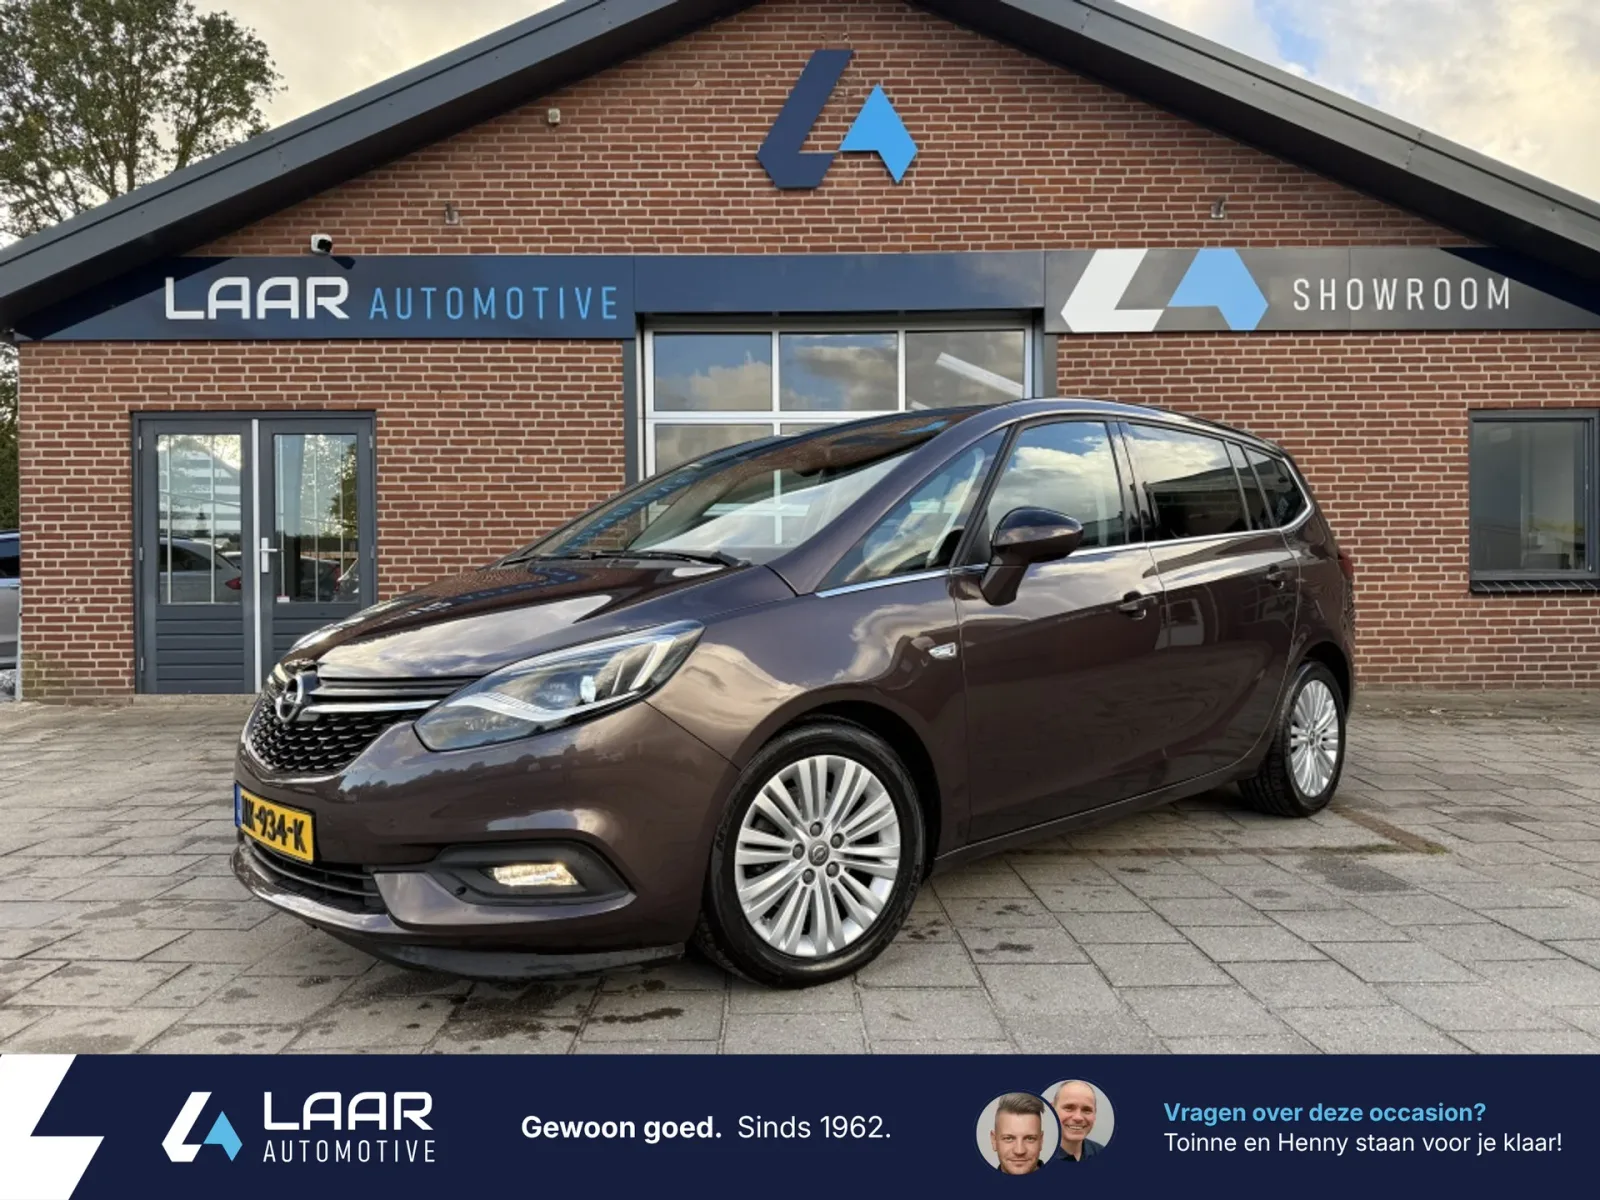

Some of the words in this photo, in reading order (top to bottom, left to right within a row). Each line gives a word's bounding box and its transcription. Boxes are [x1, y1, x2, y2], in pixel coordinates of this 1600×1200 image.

[164, 275, 350, 320] LAAR
[369, 285, 618, 320] AUTOMOTIVE
[1292, 277, 1511, 312] SHOWROOM
